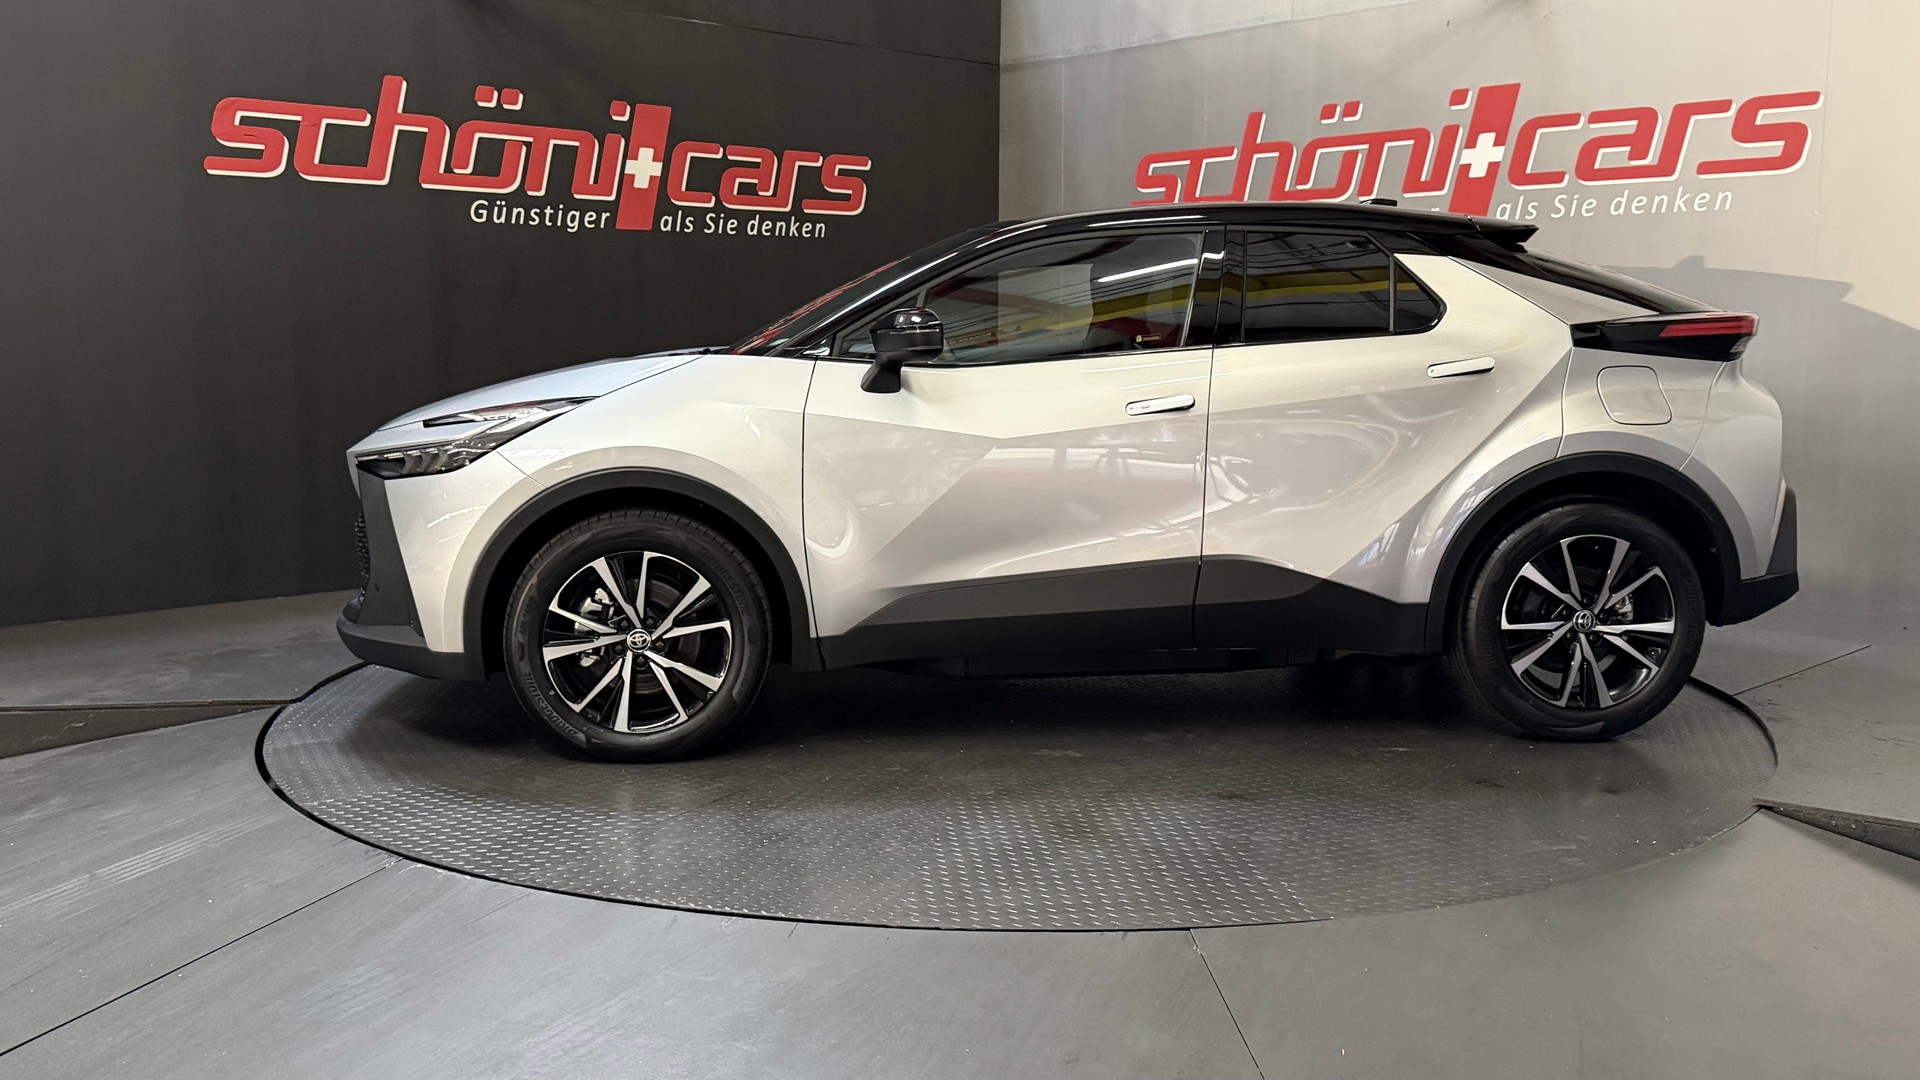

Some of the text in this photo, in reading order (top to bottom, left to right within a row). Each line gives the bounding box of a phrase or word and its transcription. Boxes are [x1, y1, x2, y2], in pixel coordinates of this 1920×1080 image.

[469, 199, 827, 239] Günstiger als Sie denken
[1495, 190, 1734, 221] als Sie denken
